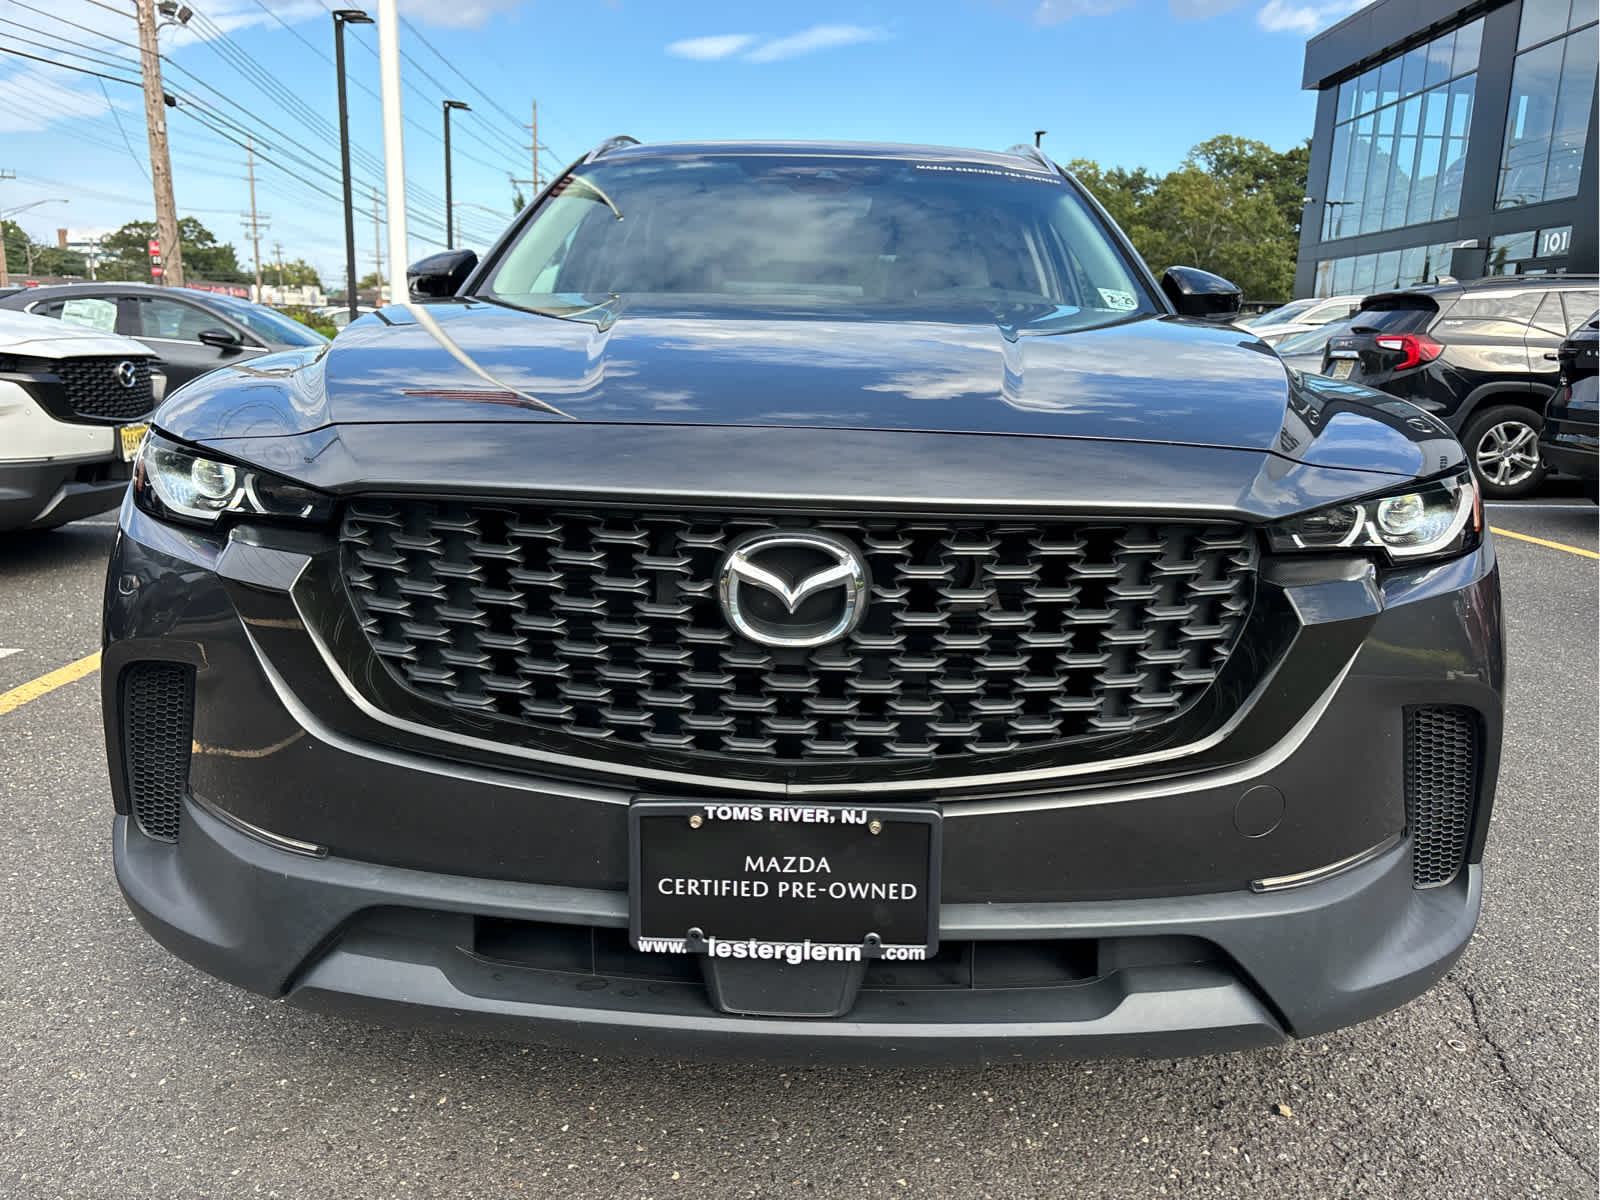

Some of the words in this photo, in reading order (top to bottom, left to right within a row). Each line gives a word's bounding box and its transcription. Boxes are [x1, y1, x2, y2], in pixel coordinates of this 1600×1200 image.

[1543, 231, 1568, 252] 101
[703, 805, 763, 822] TOMS
[769, 807, 836, 824] RIVER,
[841, 809, 868, 825] NJ
[744, 855, 832, 873] MAZDA
[658, 878, 769, 898] CERTIFIED
[778, 881, 917, 900] PRE-OWNED
[708, 935, 862, 965] lesterglenn
